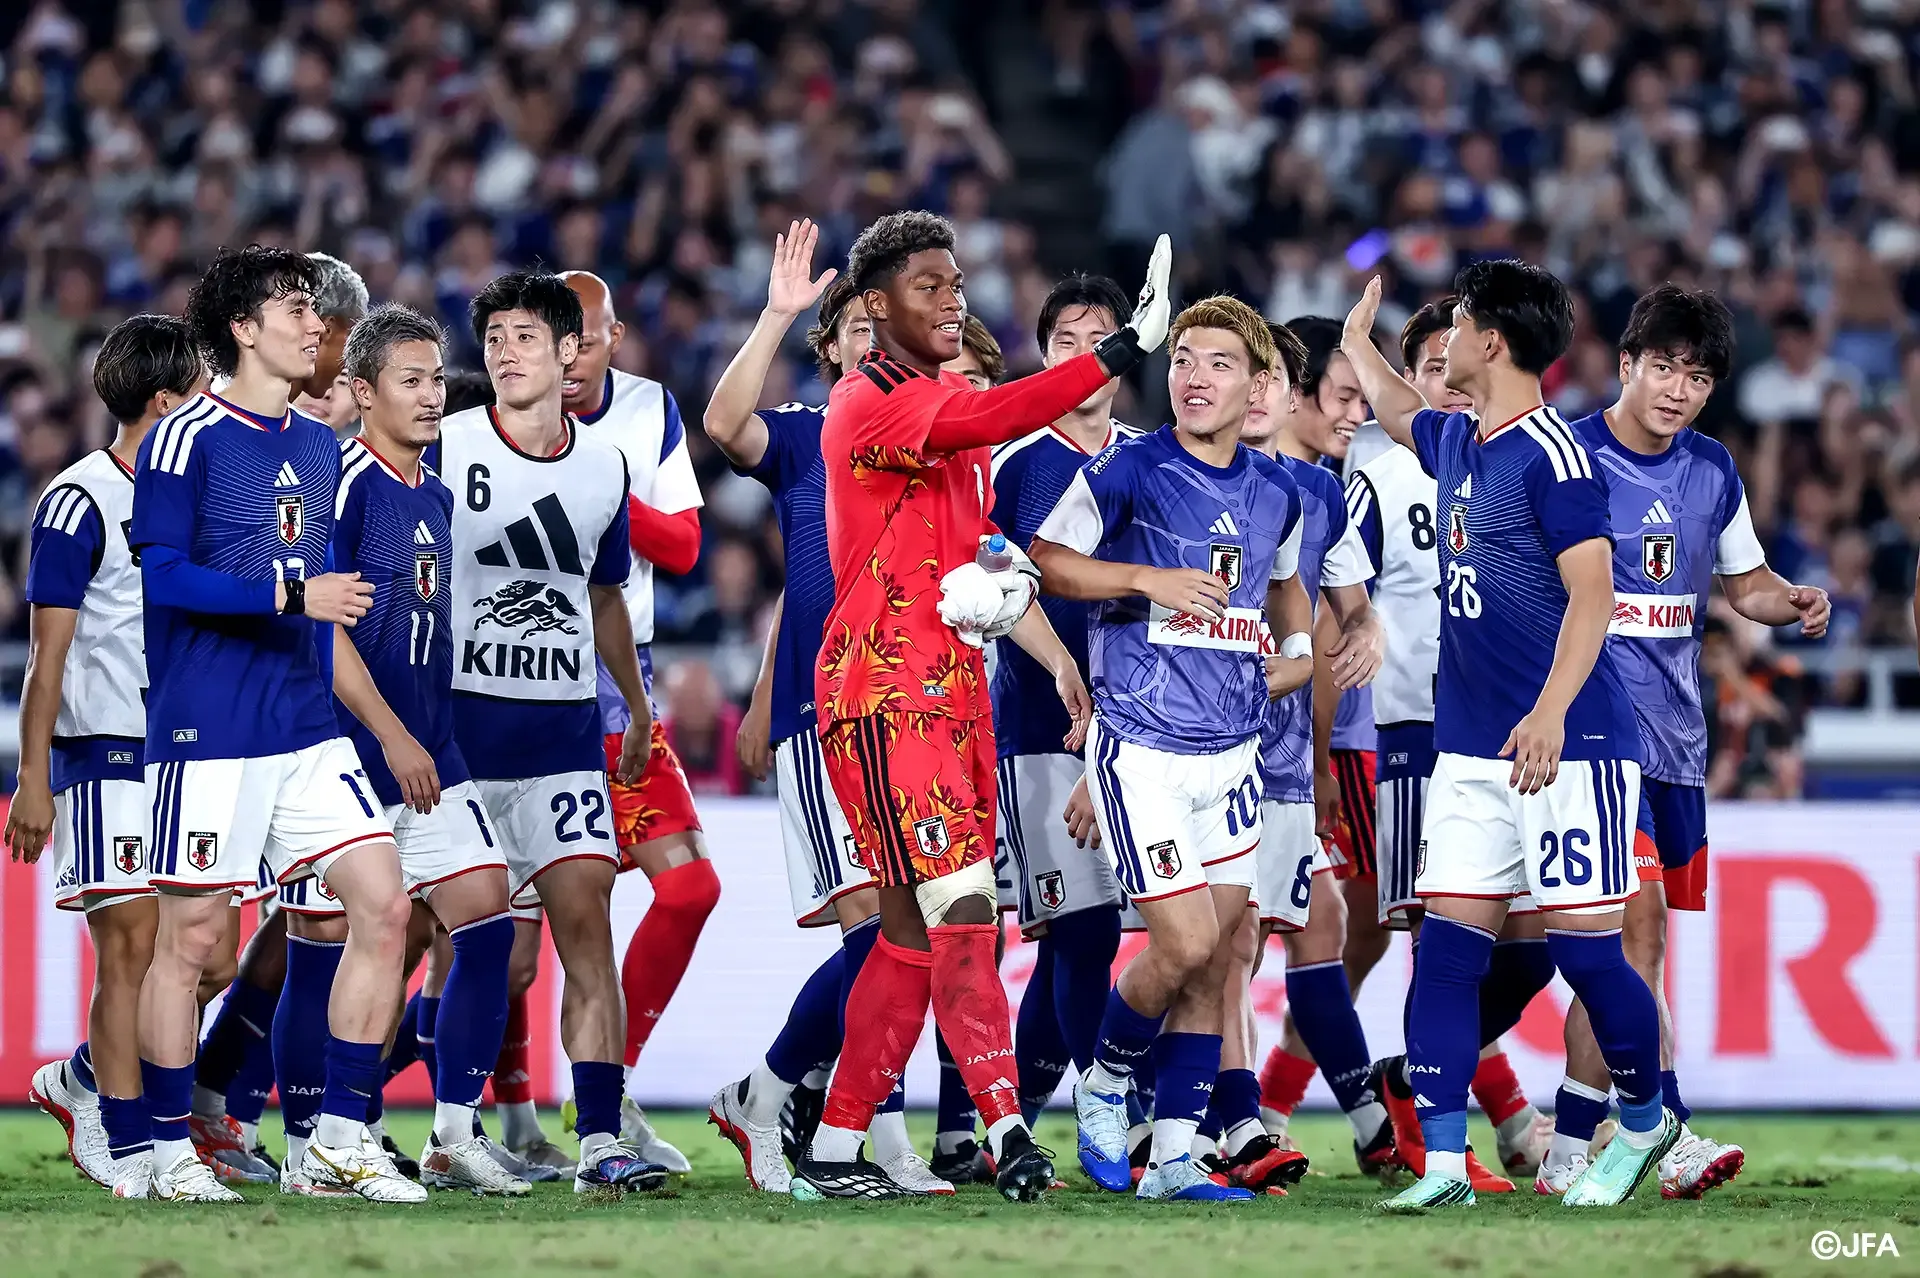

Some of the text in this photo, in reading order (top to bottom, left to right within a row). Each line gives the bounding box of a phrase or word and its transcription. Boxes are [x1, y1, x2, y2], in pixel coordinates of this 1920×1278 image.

[1090, 446, 1121, 475] DREAM
[467, 462, 492, 513] 6
[1408, 503, 1437, 551] 8
[1447, 560, 1482, 619] 26
[410, 610, 435, 666] 11
[1207, 616, 1262, 644] KIRIN
[1649, 604, 1695, 628] KIRIN
[461, 639, 582, 682] KIRIN
[551, 790, 611, 843] 22
[1225, 774, 1260, 836] 10
[1153, 842, 1172, 850] JAPAN
[1540, 828, 1593, 888] 26
[1290, 855, 1314, 910] 8
